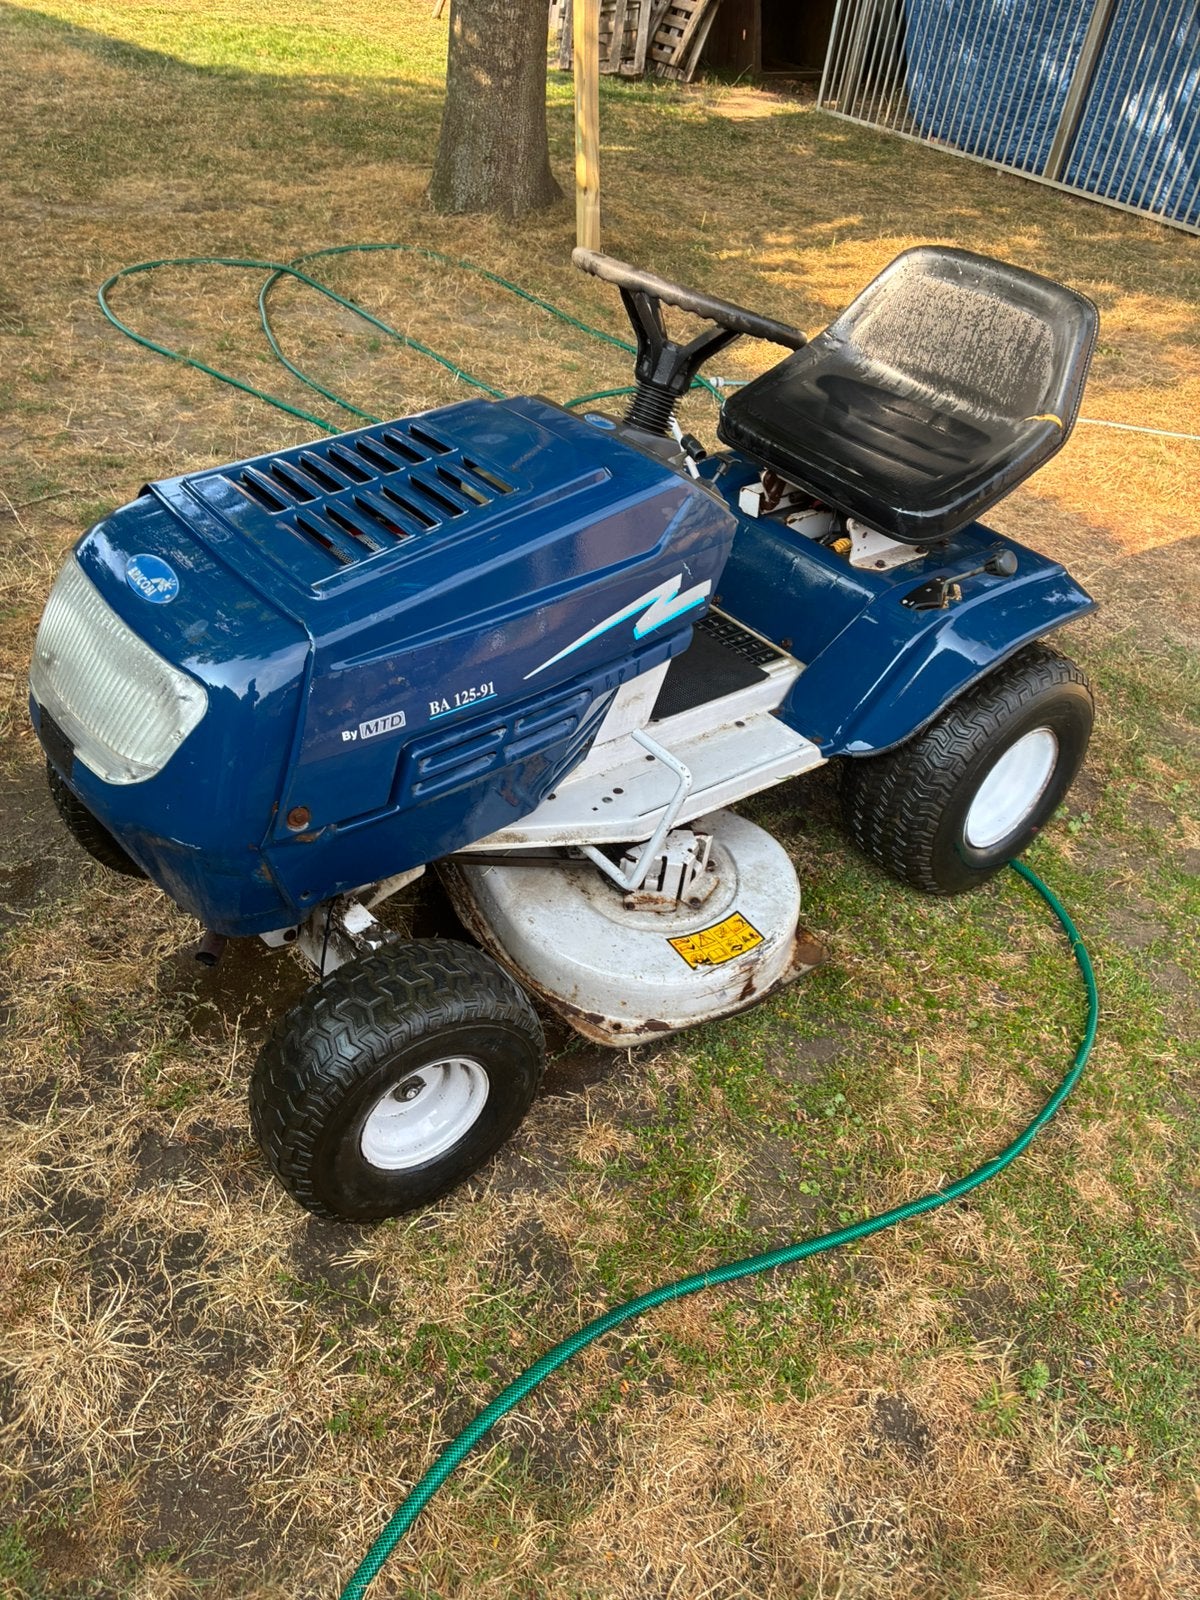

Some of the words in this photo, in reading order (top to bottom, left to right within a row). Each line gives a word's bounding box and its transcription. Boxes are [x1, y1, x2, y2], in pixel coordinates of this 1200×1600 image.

[429, 698, 450, 716] BA
[454, 681, 495, 707] 125-91
[341, 731, 358, 742] By
[363, 714, 403, 737] MTD
